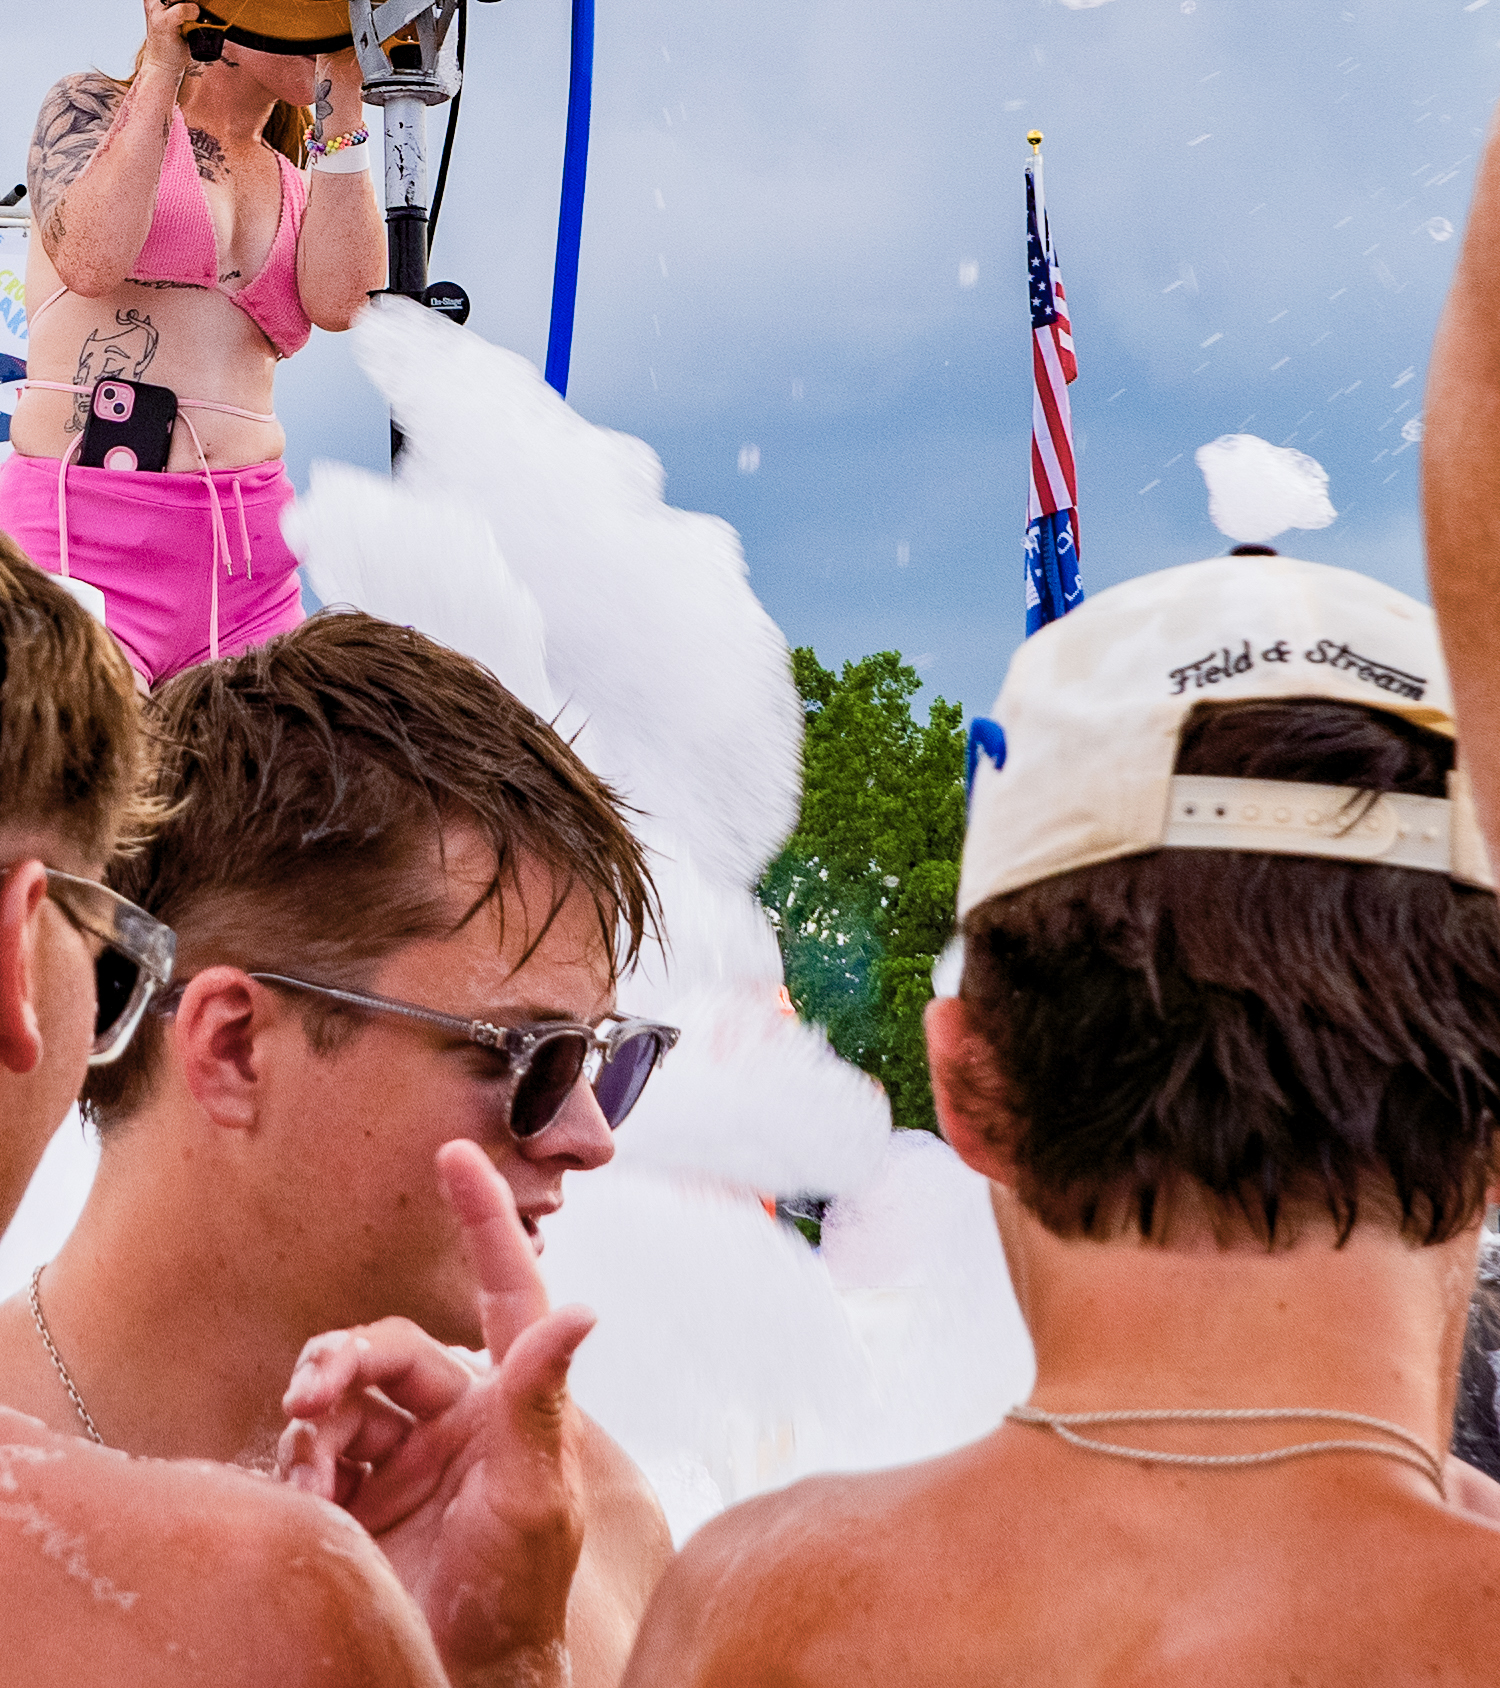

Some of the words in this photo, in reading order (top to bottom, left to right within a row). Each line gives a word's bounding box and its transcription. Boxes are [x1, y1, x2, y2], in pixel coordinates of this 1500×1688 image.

[1168, 638, 1254, 696] Field
[1261, 640, 1292, 664] &
[1305, 638, 1428, 702] Stream
